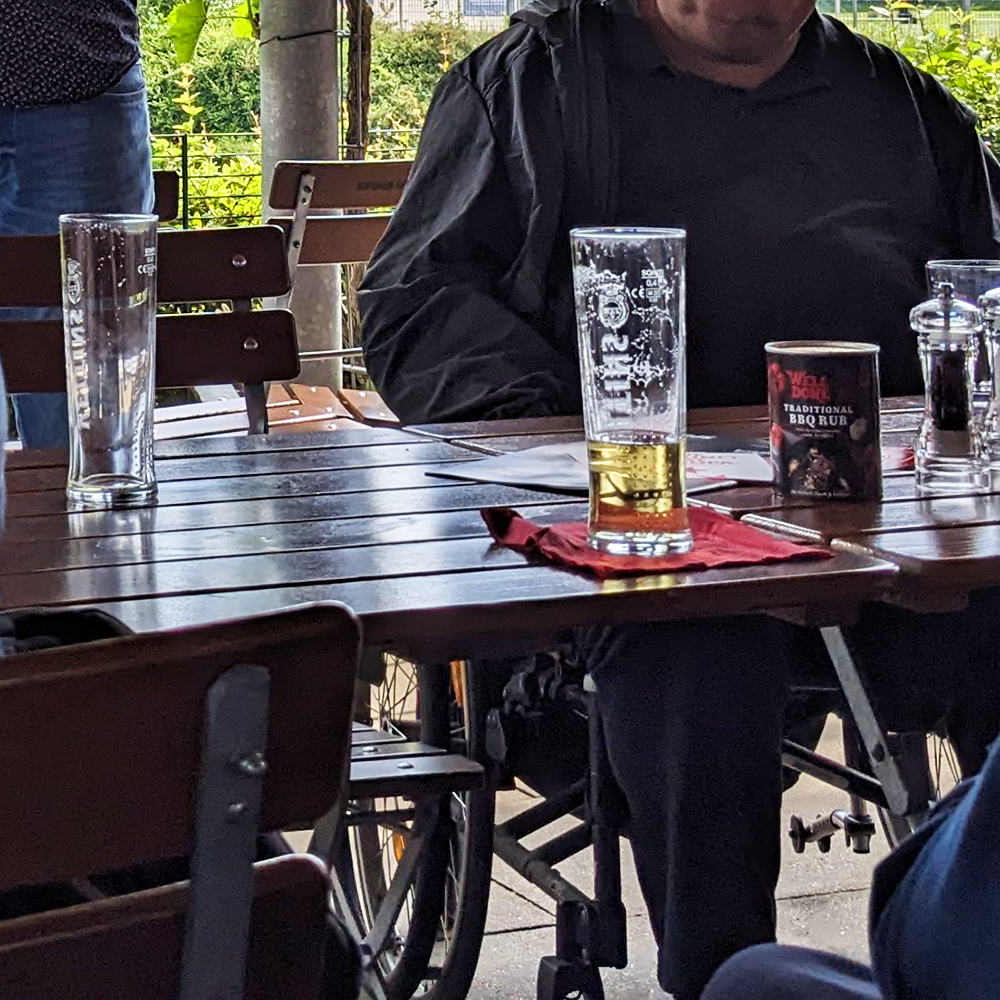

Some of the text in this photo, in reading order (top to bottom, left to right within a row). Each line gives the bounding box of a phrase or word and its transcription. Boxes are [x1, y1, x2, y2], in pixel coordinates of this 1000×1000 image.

[783, 403, 854, 415] TRADITIONAL
[789, 413, 848, 428] BBQ RUB
